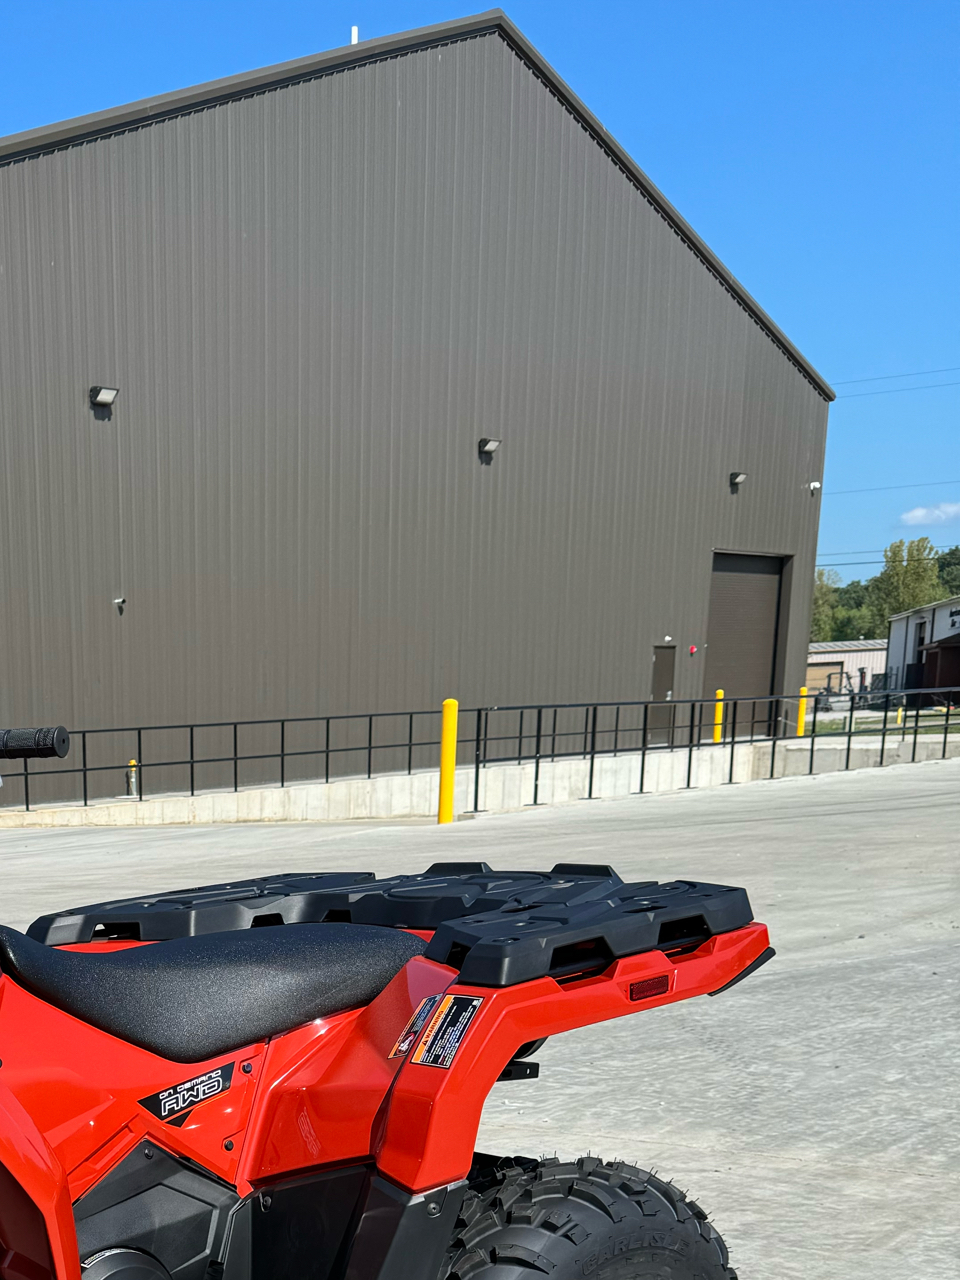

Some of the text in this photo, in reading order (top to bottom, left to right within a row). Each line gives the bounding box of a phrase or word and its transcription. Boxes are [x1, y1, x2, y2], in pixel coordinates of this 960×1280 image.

[425, 1010, 444, 1039] WARNING
[159, 1069, 222, 1100] ON DEMAND
[161, 1077, 223, 1116] AWD
[581, 1231, 691, 1276] CARLISLE
